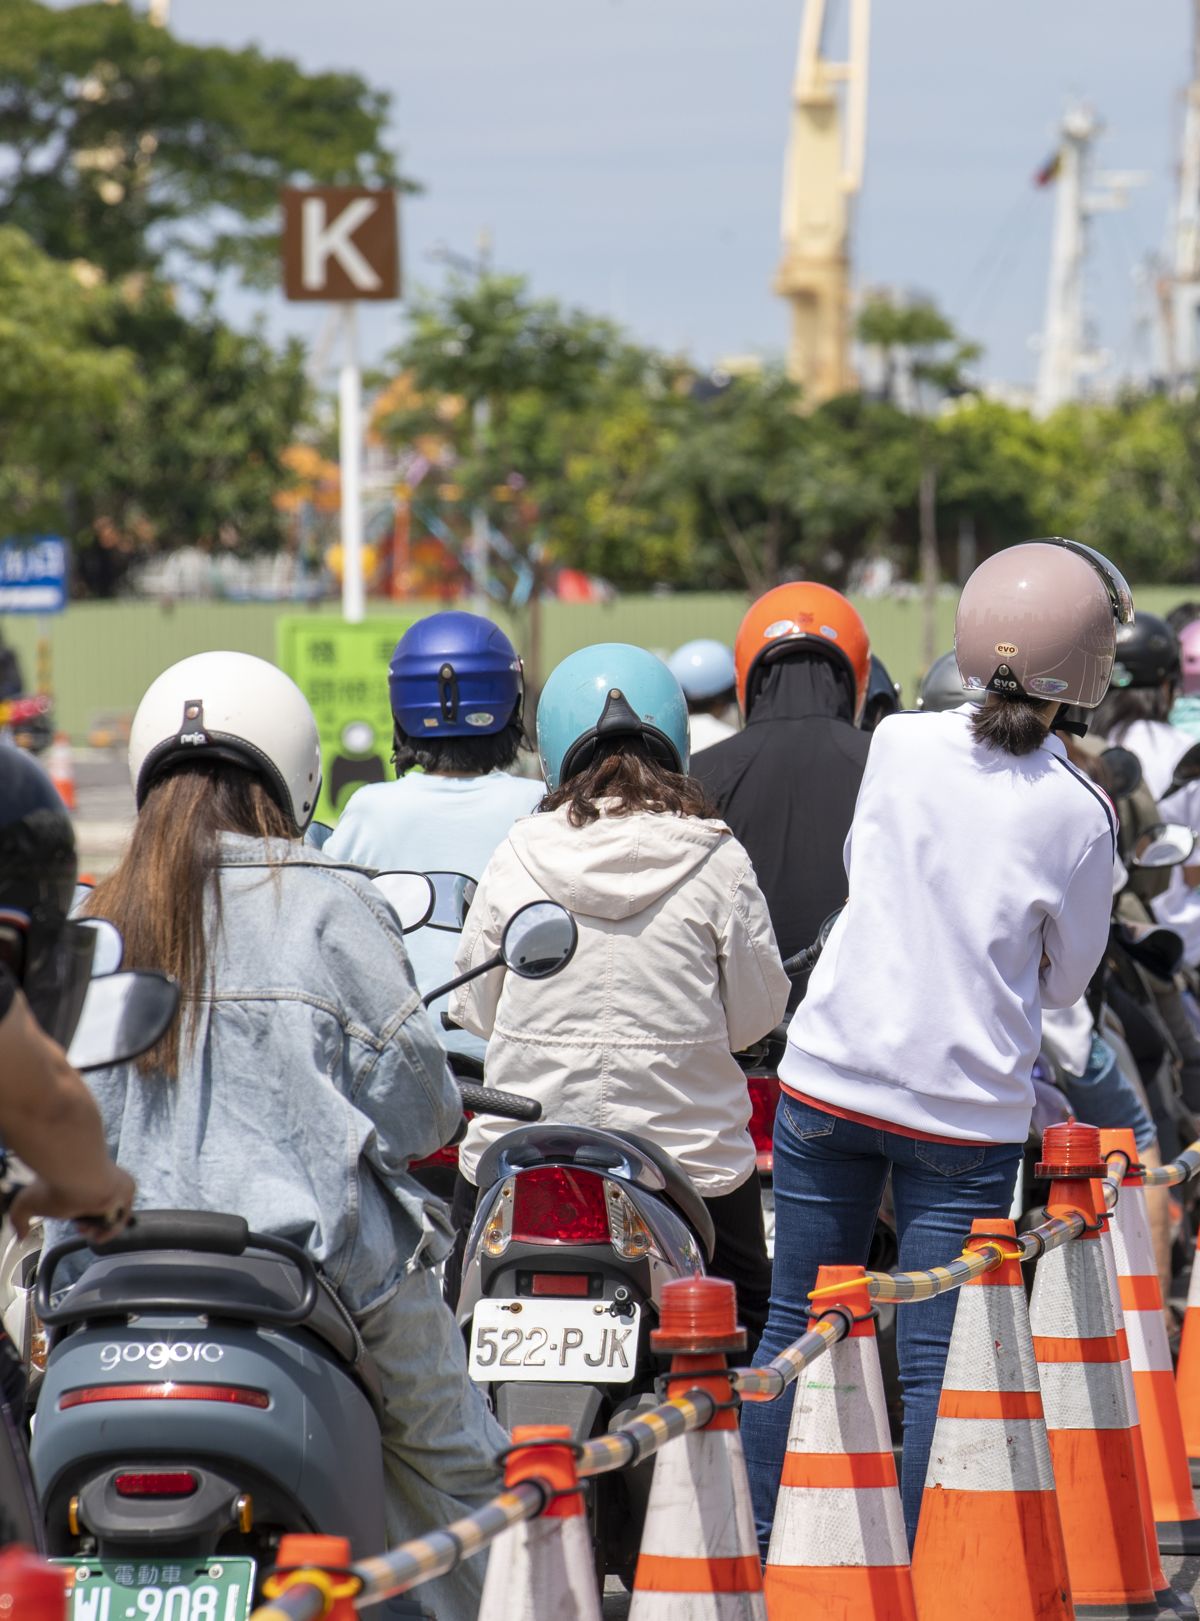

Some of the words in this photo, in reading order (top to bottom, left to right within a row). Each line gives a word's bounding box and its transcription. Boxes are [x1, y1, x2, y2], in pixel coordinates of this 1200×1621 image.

[302, 197, 383, 291] K
[997, 645, 1016, 653] evo
[993, 678, 1017, 688] evo
[100, 1342, 224, 1371] gogoro
[476, 1327, 633, 1368] 522-PJK
[115, 1565, 181, 1585] 電動車
